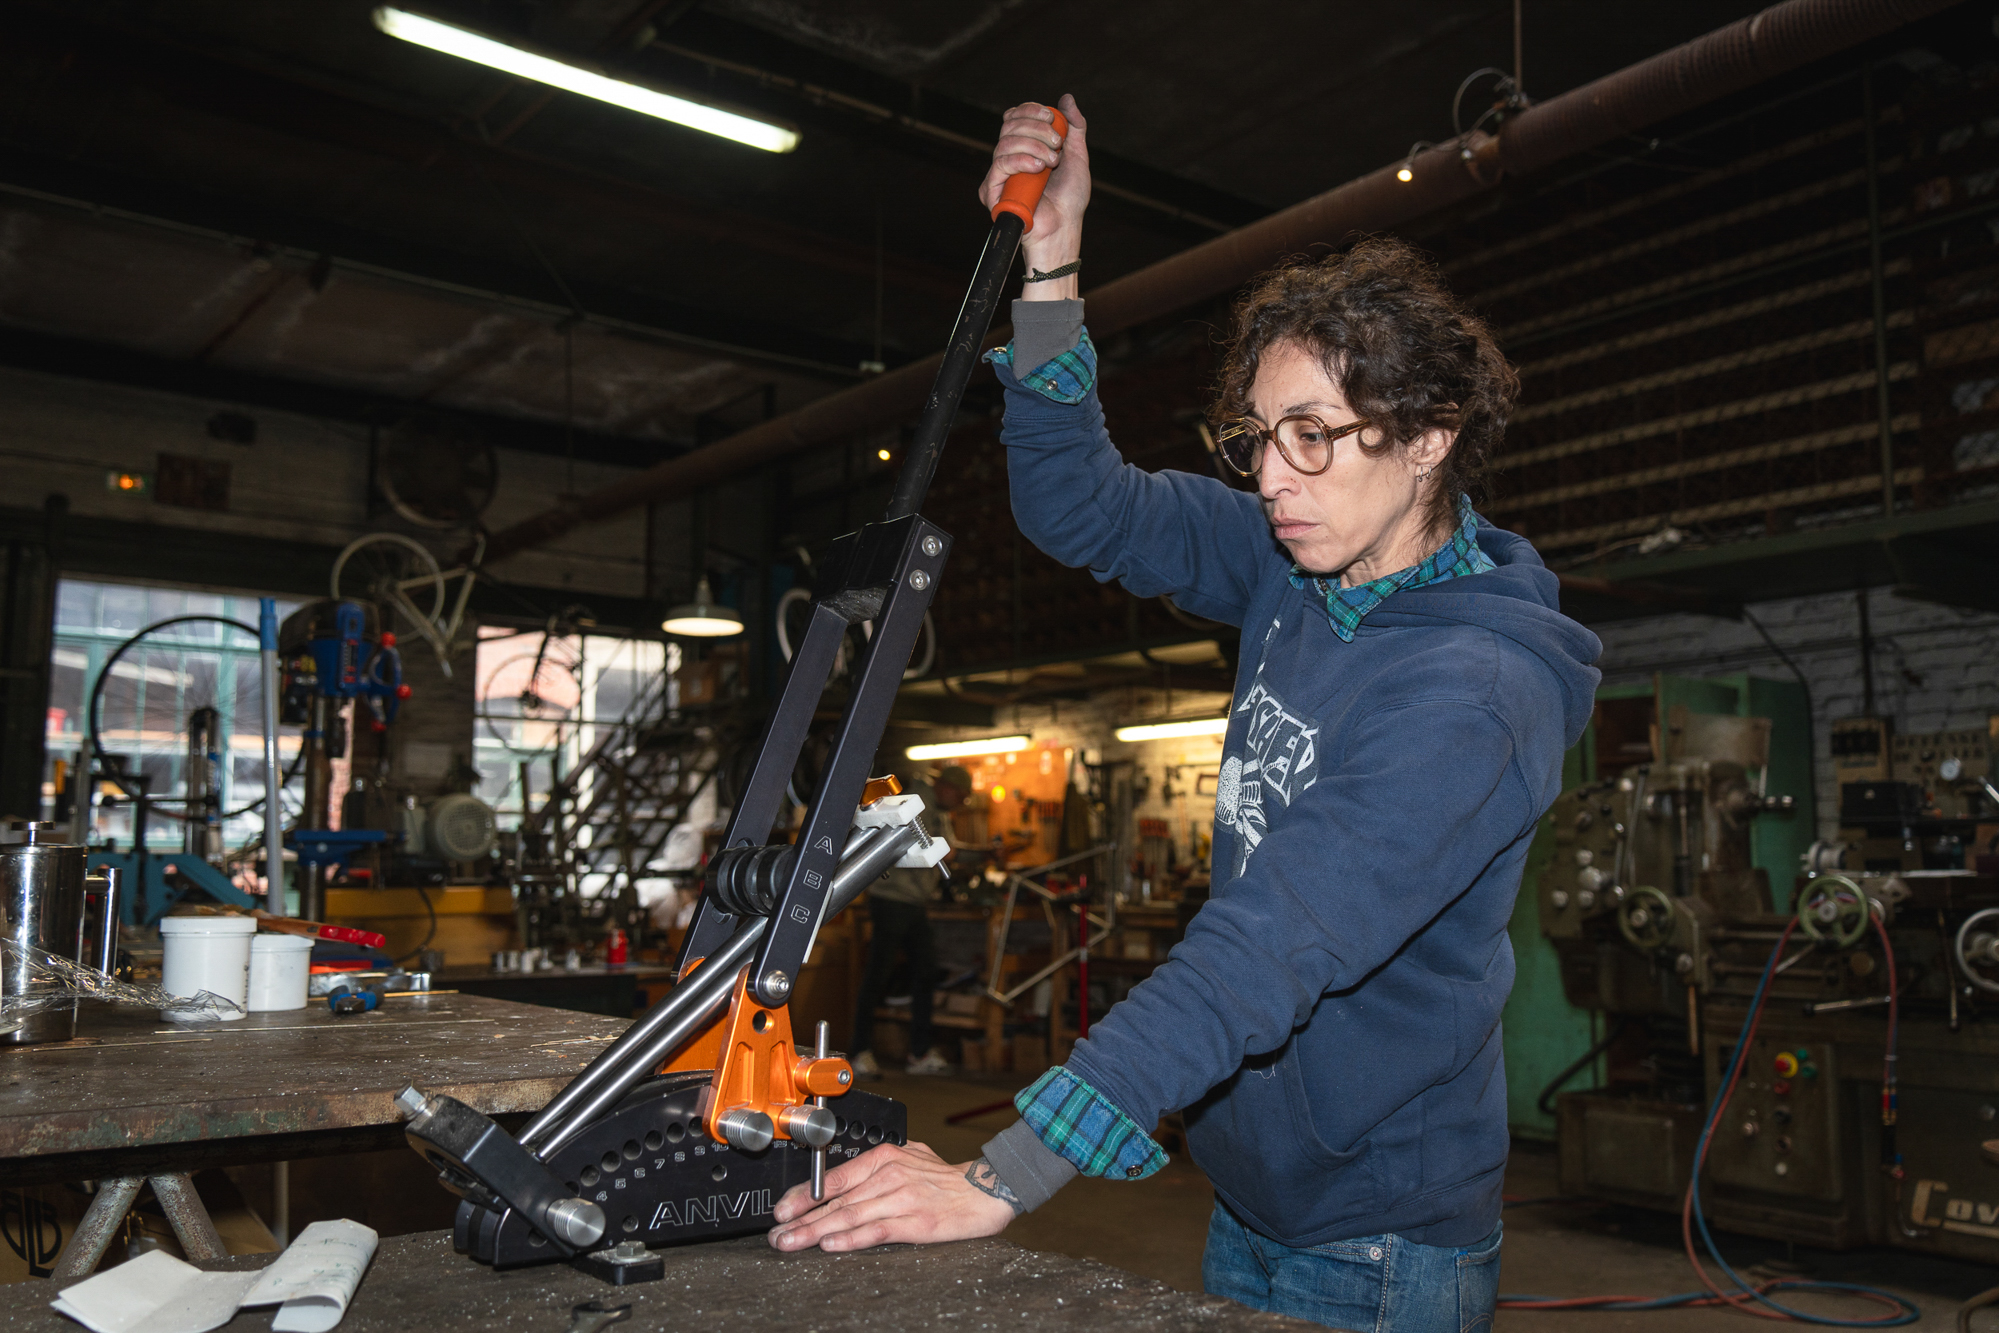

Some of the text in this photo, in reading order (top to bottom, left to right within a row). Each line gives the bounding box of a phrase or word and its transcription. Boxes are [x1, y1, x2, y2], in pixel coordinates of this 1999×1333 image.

[814, 835, 833, 856] A
[803, 869, 823, 890] B
[790, 903, 811, 924] C
[596, 1190, 608, 1202] 4
[615, 1178, 626, 1189] 5
[634, 1167, 646, 1178] 6
[654, 1158, 665, 1169] 7
[674, 1151, 685, 1162] 8
[694, 1145, 706, 1156] 9
[844, 1147, 861, 1158] 17
[649, 1188, 776, 1230] ANVIL
